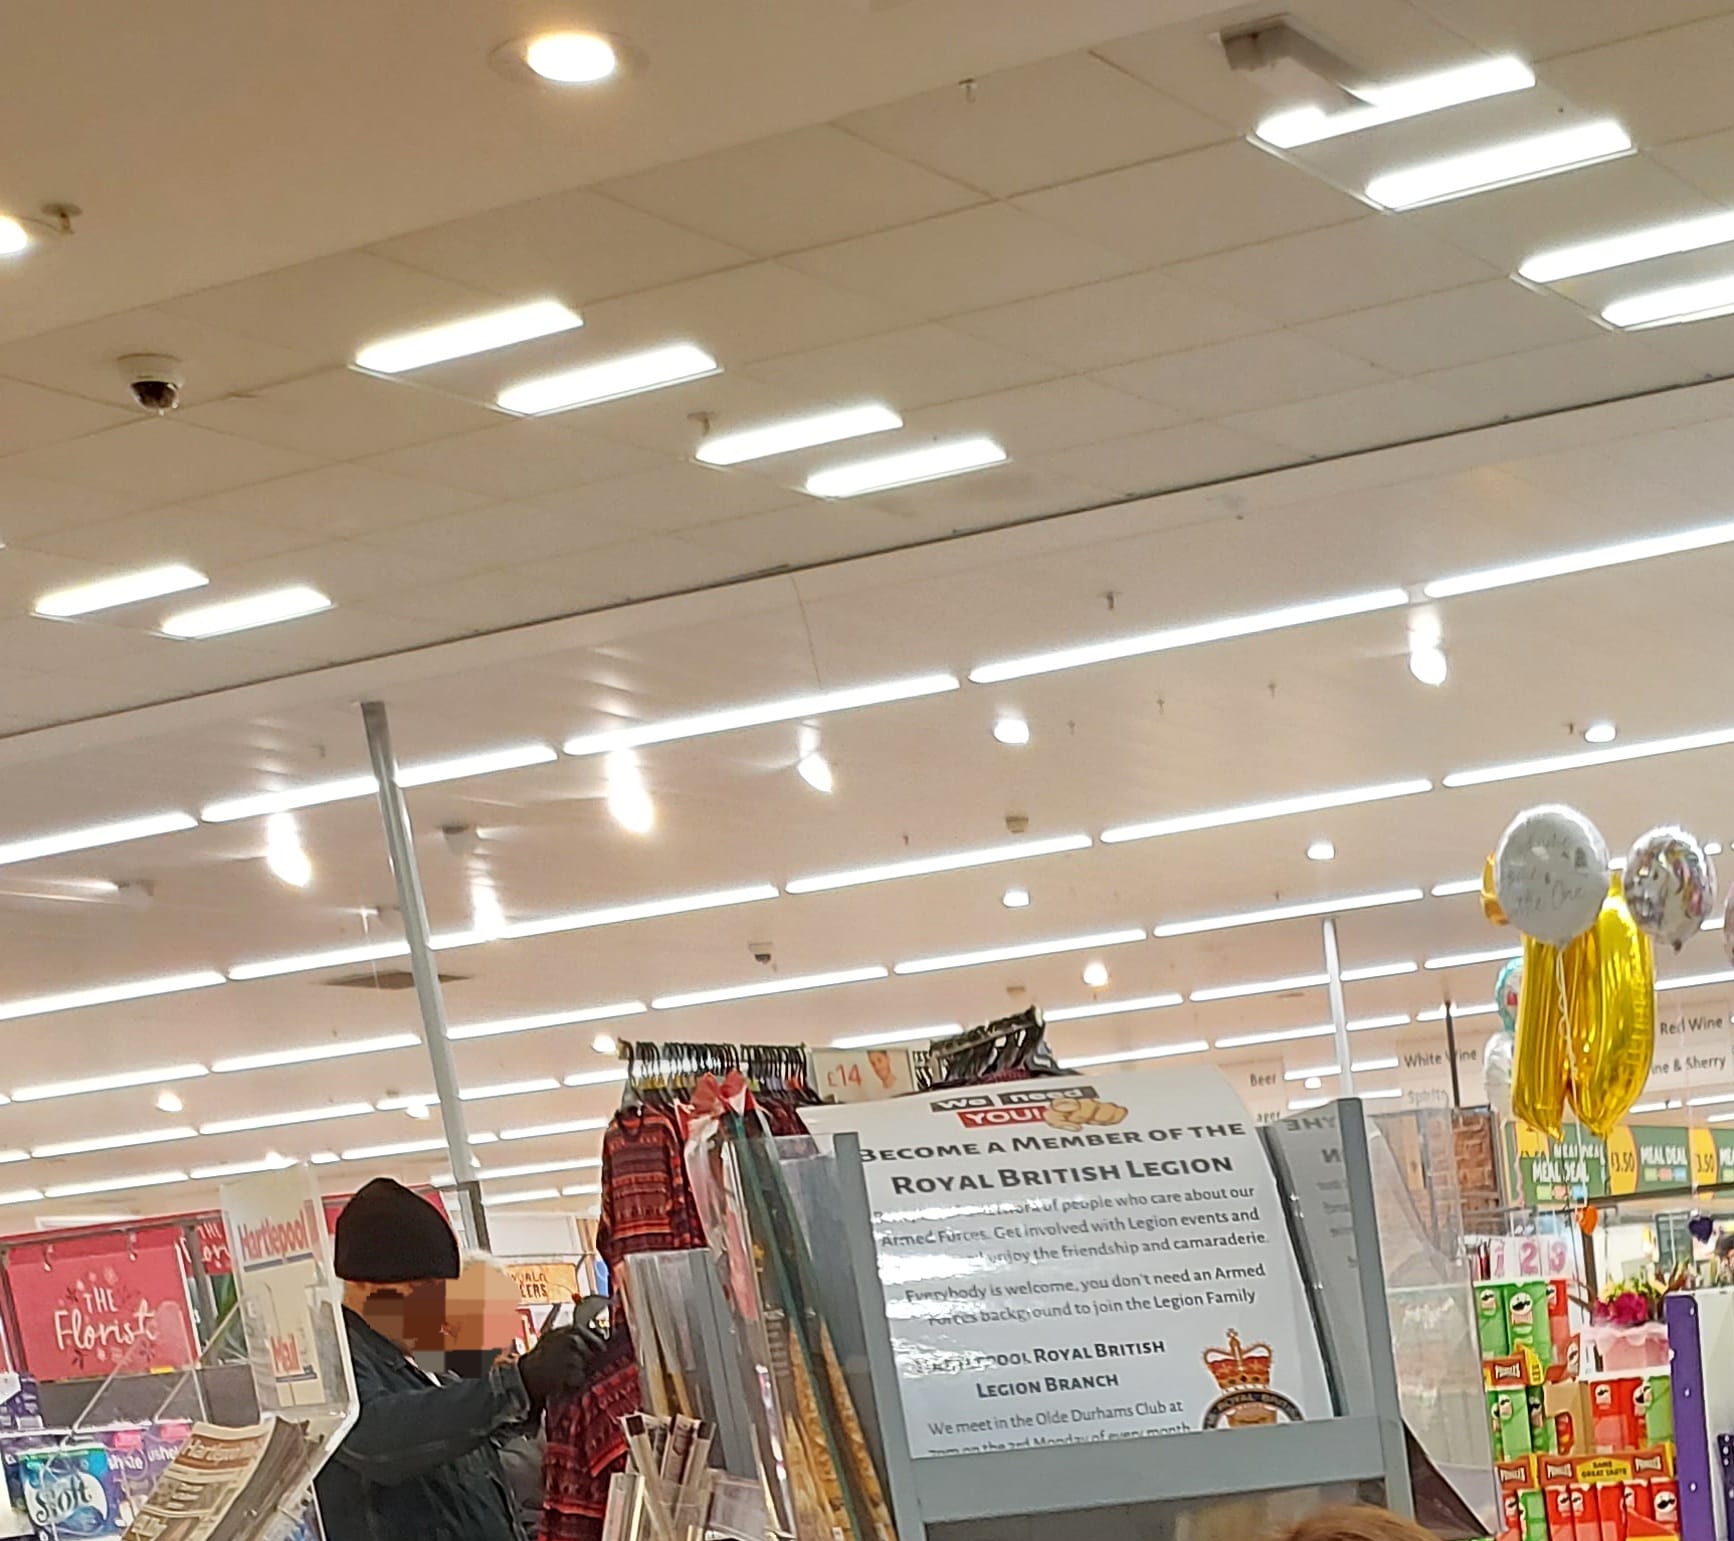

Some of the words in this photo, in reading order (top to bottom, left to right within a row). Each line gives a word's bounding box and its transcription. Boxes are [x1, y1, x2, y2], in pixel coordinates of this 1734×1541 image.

[1660, 1019, 1685, 1036] Red
[1687, 1015, 1724, 1033] Wine
[1404, 1052, 1444, 1069] White
[1640, 1145, 1663, 1166] MEAL
[1664, 1143, 1687, 1165] DEAL
[891, 1173, 994, 1195] ROYAL
[1000, 1163, 1120, 1188] BRITISH
[1126, 1156, 1234, 1179] LEGION
[1063, 1194, 1113, 1213] people
[1115, 1193, 1148, 1207] who
[1150, 1191, 1181, 1205] care
[1184, 1188, 1230, 1203] about
[1232, 1185, 1256, 1199] our
[242, 1217, 314, 1261] Hartlepool
[989, 1283, 1002, 1298] is
[1080, 1276, 1110, 1294] you
[1111, 1272, 1151, 1289] don't
[1154, 1270, 1191, 1286] need
[1194, 1268, 1212, 1282] an
[1214, 1263, 1266, 1279] Armed
[84, 1287, 117, 1311] THE
[980, 1303, 1072, 1324] background
[1075, 1302, 1092, 1316] to
[1093, 1299, 1123, 1317] join
[1126, 1295, 1151, 1311] the
[1153, 1292, 1203, 1312] Legion
[1206, 1287, 1257, 1307] Family
[55, 1298, 156, 1350] Florist
[1033, 1344, 1093, 1364] ROYAL
[1095, 1339, 1166, 1358] BRITISH
[976, 1380, 1041, 1400] LEGION
[1045, 1374, 1120, 1394] BRANCH
[928, 1421, 953, 1437] We
[956, 1420, 993, 1435] meet
[994, 1418, 1009, 1431] in
[1011, 1415, 1034, 1430] the
[1036, 1409, 1069, 1427] Olde
[1071, 1404, 1135, 1424] Durhams
[1136, 1400, 1167, 1417] Club
[1169, 1399, 1184, 1413] at
